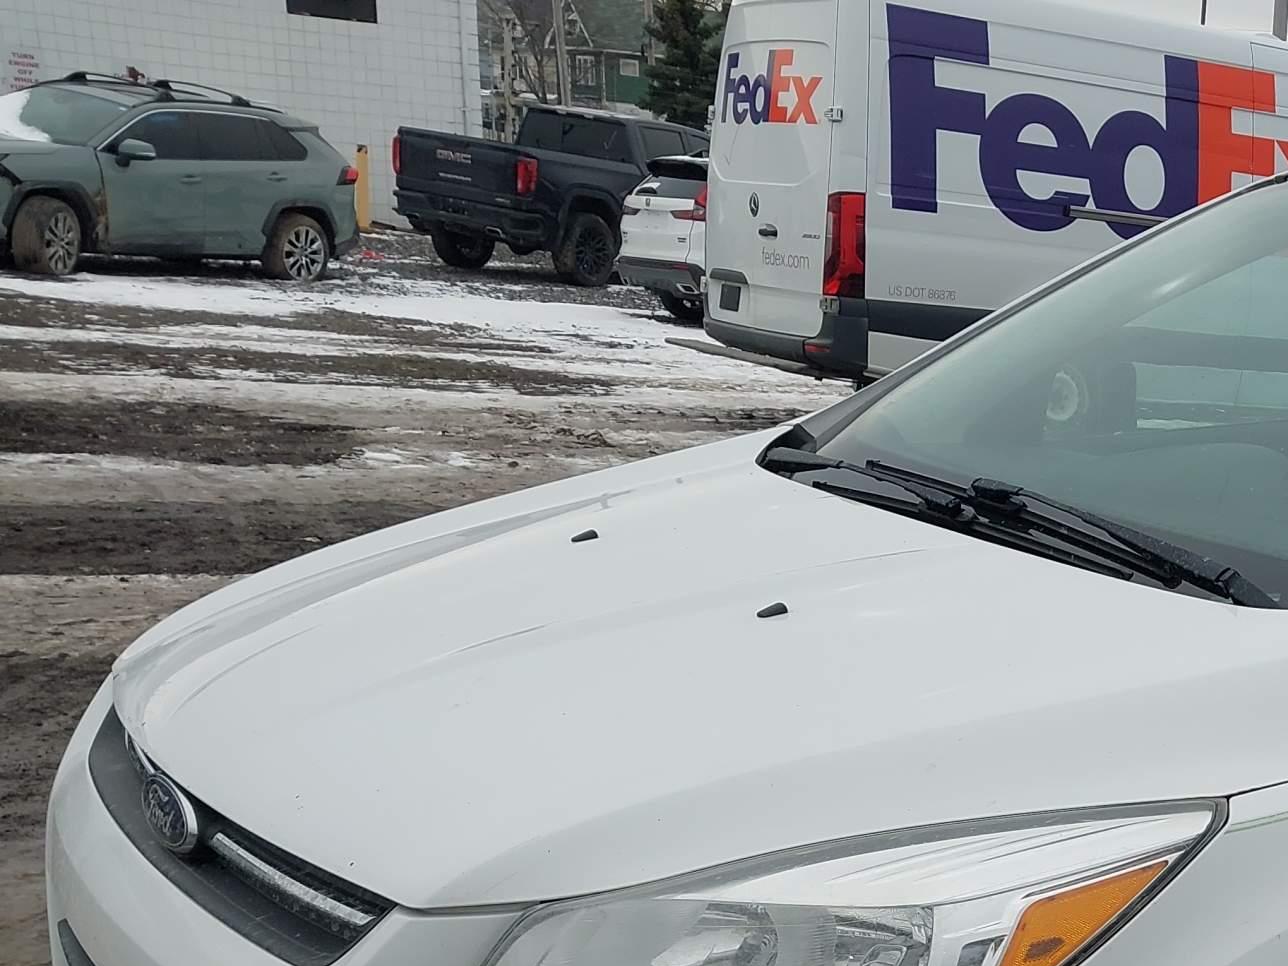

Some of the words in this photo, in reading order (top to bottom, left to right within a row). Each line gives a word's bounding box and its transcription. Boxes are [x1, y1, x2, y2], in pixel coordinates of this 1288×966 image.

[721, 48, 823, 125] FedEx
[436, 149, 472, 164] GMC
[761, 246, 810, 270] fedex.com
[888, 284, 903, 297] US
[904, 286, 926, 299] DOT
